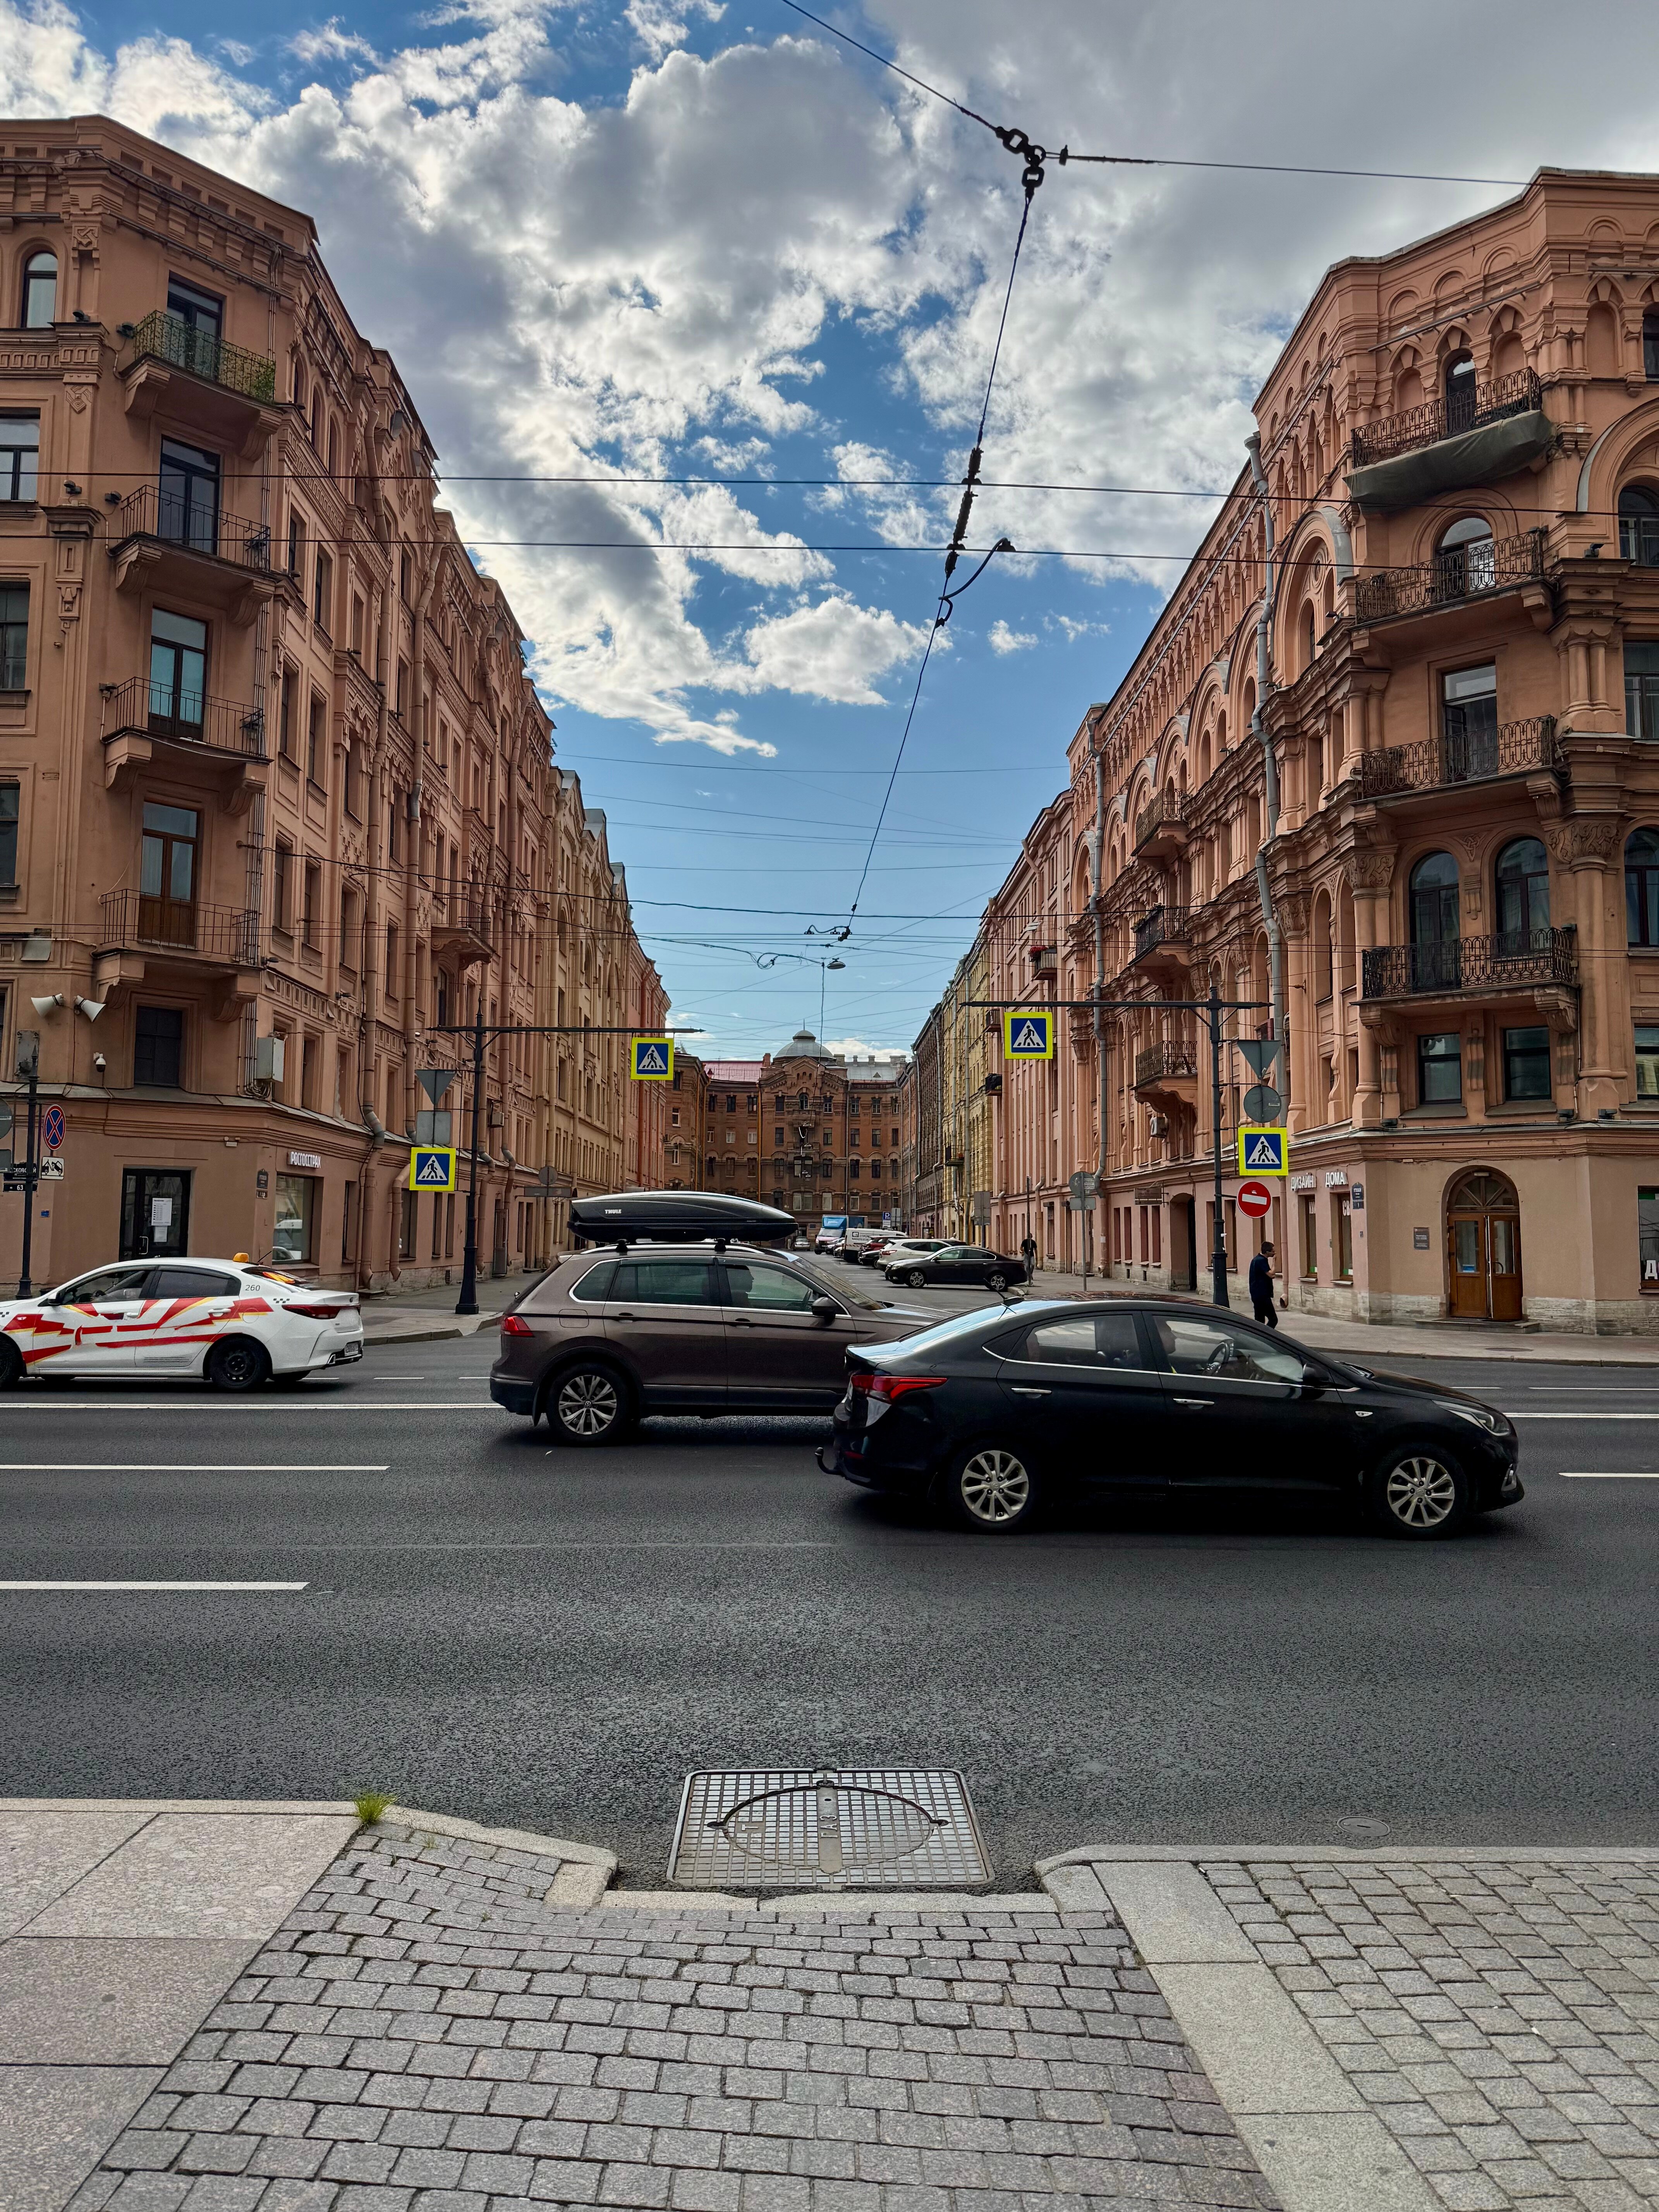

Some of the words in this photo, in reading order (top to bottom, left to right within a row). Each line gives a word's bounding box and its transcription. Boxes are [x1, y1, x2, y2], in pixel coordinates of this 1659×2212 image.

[291, 1151, 321, 1168] РОСГОССТРАХ
[1291, 1173, 1314, 1192] ДИЗАЙН
[1326, 1172, 1345, 1188] ДОМА
[820, 1815, 838, 1838] ГАЗ
